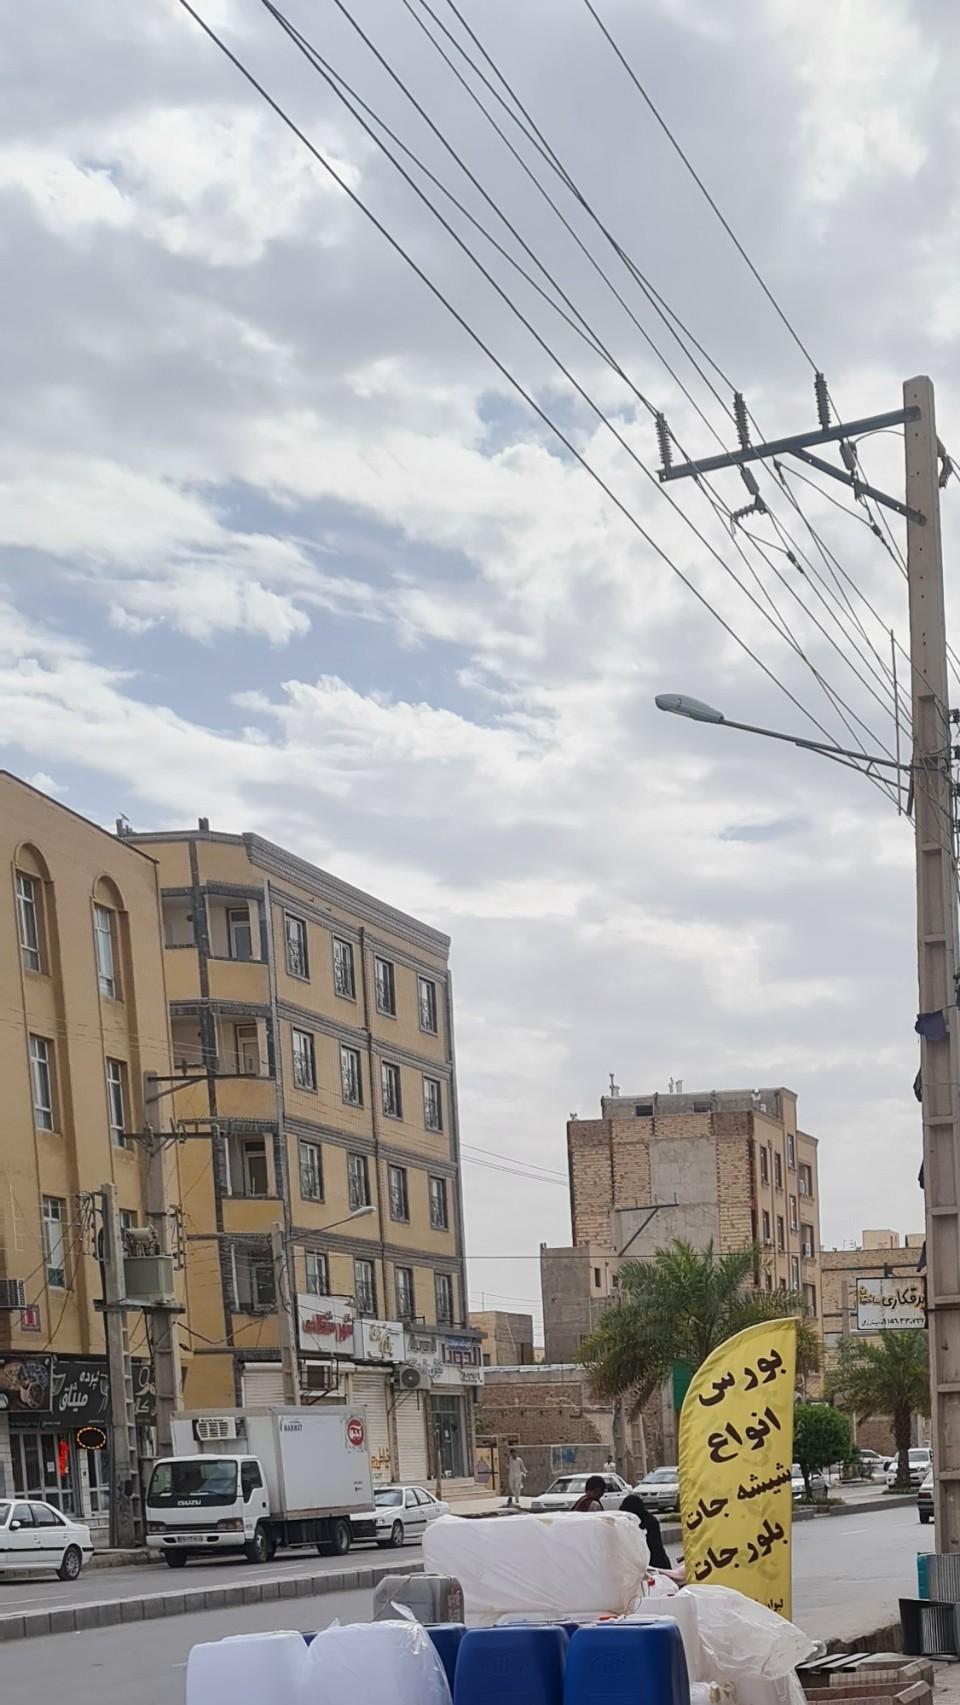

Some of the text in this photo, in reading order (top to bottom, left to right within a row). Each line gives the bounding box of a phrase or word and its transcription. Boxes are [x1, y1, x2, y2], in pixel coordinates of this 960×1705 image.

[58, 1382, 88, 1413] میثاق
[79, 1371, 100, 1390] پرده
[698, 1349, 787, 1407] بورس
[707, 1406, 781, 1463] انواع
[686, 1462, 792, 1530] شیشه جات
